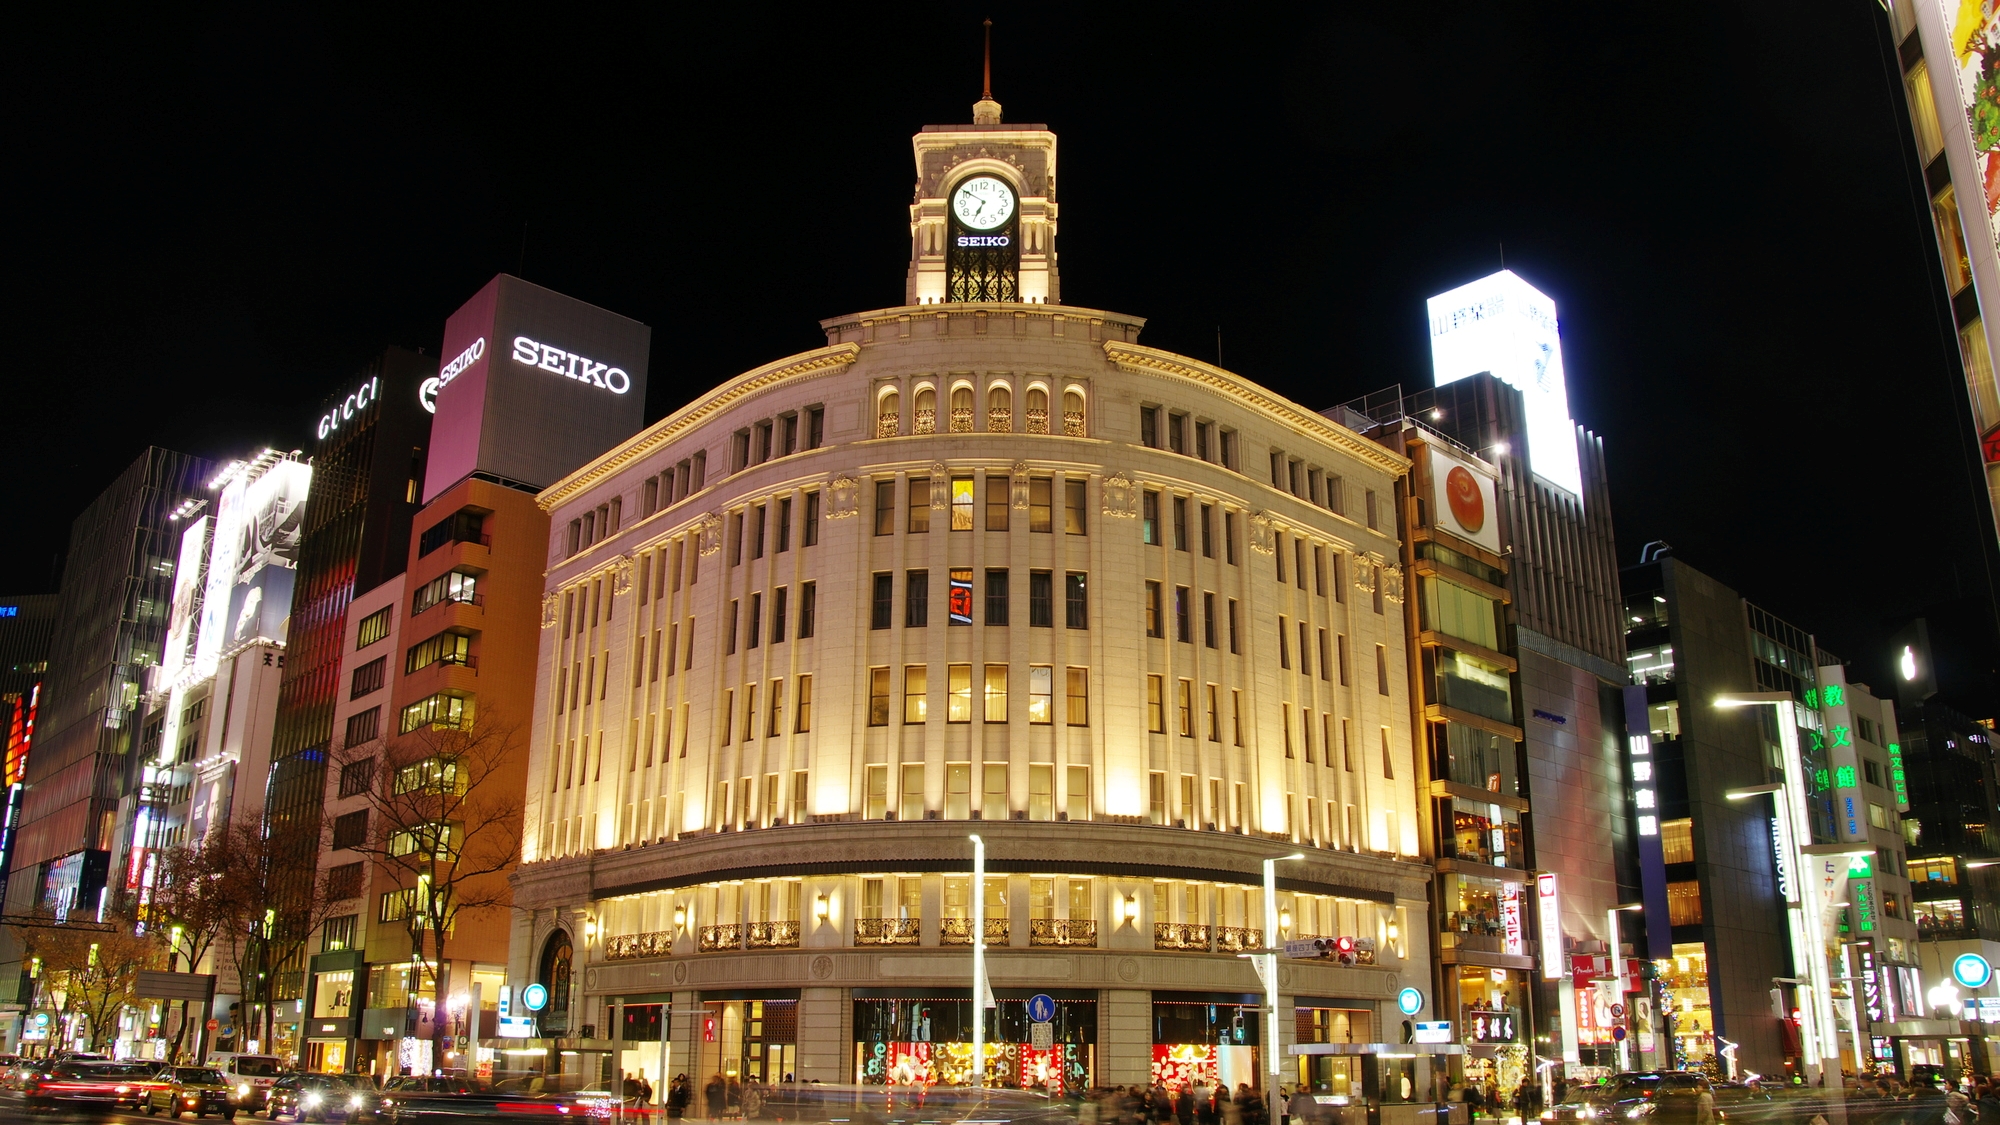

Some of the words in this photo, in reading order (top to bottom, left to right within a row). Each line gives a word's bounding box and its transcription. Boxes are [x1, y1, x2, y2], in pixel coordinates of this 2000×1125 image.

[980, 182, 988, 190] 12
[998, 190, 1005, 198] 2
[959, 200, 966, 208] 9
[1002, 199, 1008, 207] 3
[963, 208, 969, 216] 8
[990, 215, 996, 223] 5
[980, 217, 986, 225] 6
[957, 236, 1009, 247] SEIKO
[439, 337, 486, 388] SEIKO
[512, 336, 631, 395] SEIKO
[317, 376, 379, 440] GUCCI
[1824, 684, 1857, 789] 教文館
[1888, 743, 1908, 805] 教文館ビル
[1629, 735, 1658, 836] 山野楽器
[1845, 797, 1856, 818] SINCE
[1856, 883, 1872, 931] ナルニア国
[1573, 966, 1594, 975] Fender
[1863, 970, 1881, 1021] ヨシノヤ
